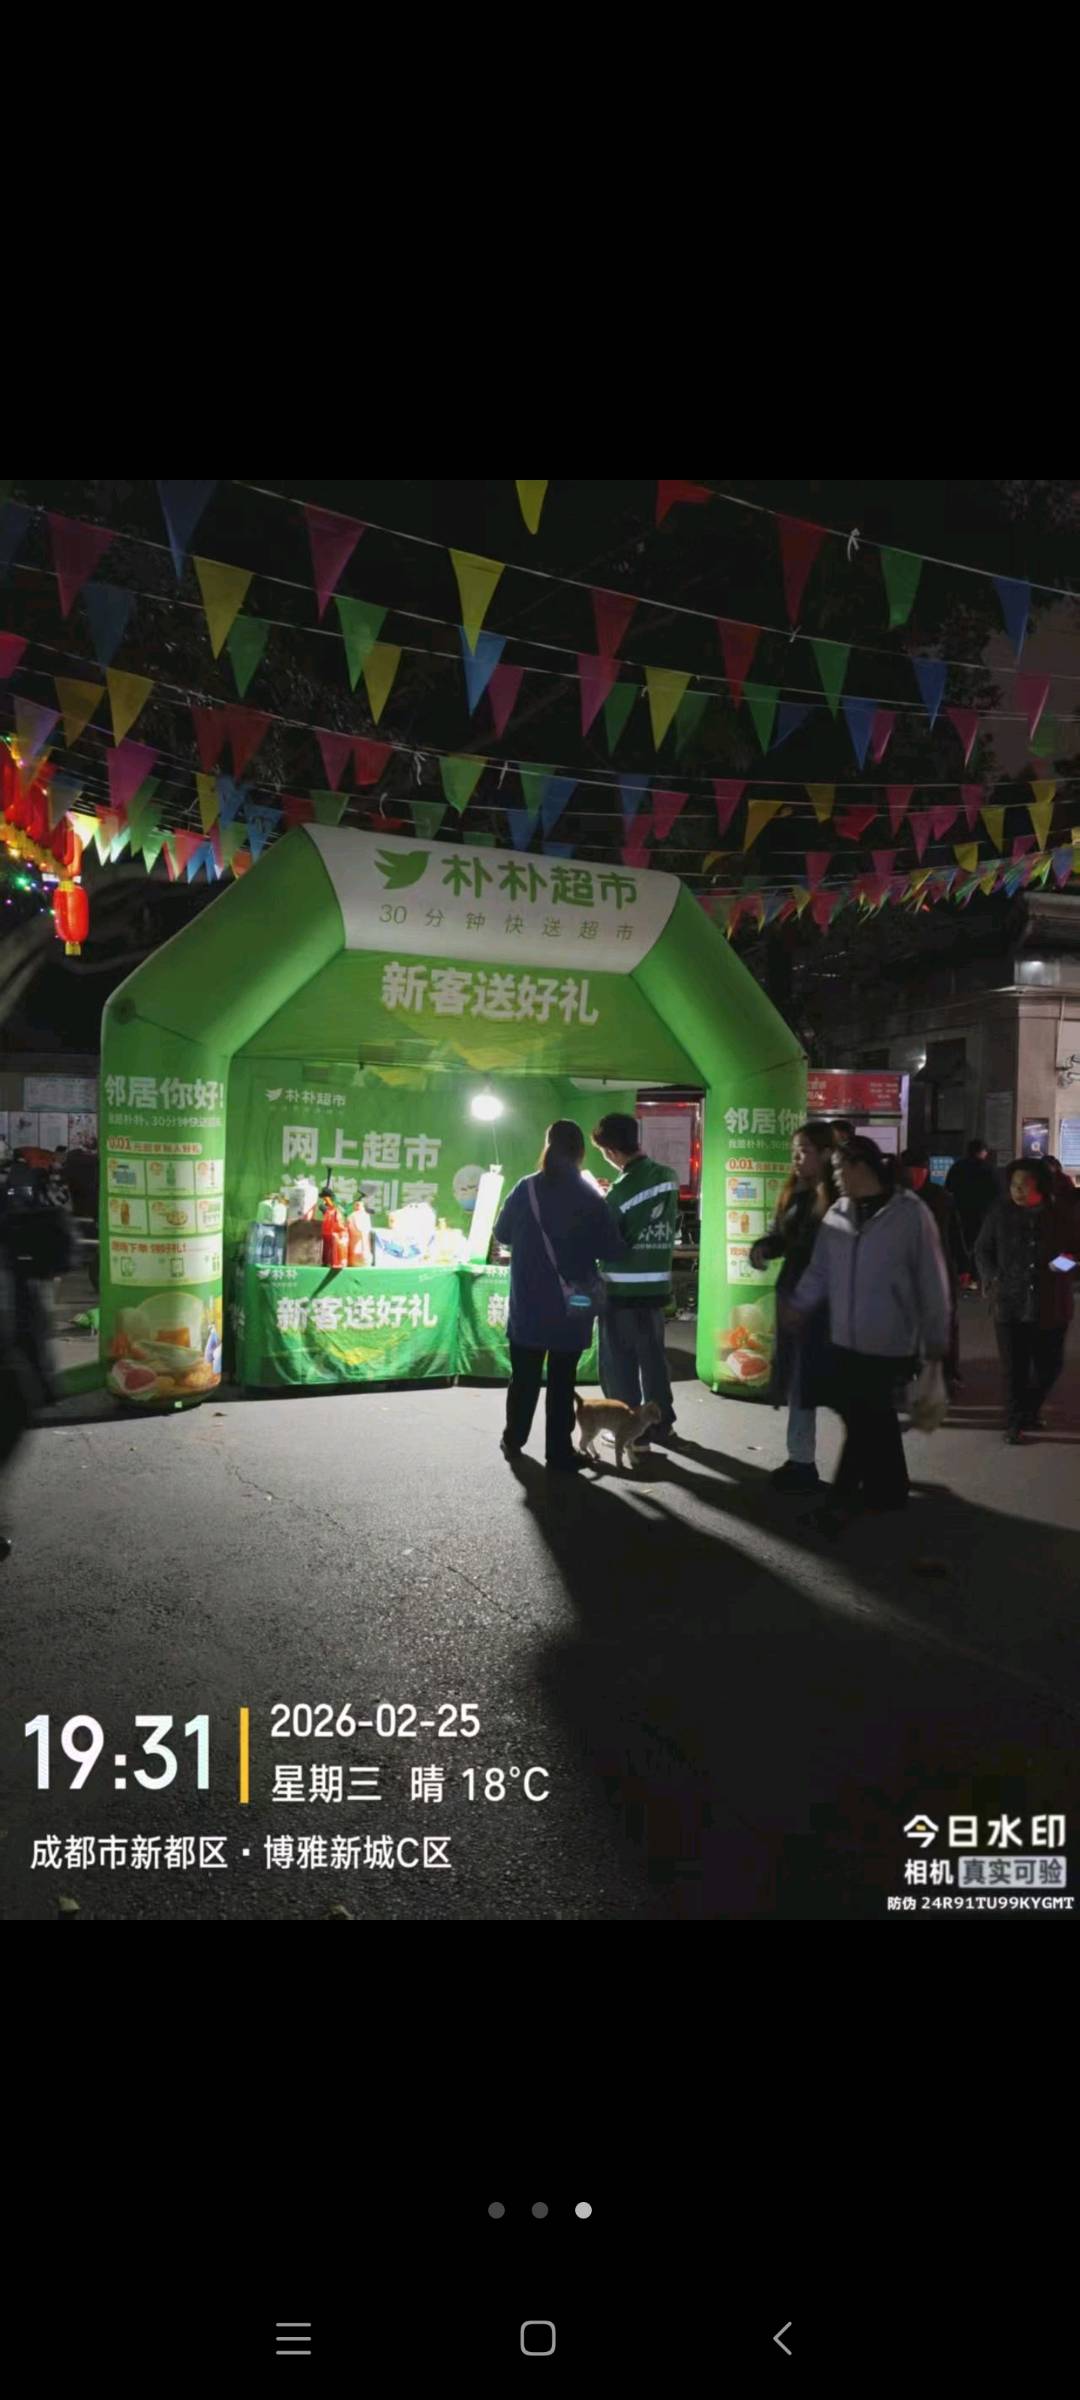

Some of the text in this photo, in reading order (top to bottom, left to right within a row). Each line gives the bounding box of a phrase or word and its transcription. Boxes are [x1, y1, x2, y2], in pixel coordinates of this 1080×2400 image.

[440, 854, 639, 911] 朴朴超市
[379, 904, 634, 941] 30分钟快送超市
[381, 961, 600, 1026] 新客送好礼
[285, 1089, 346, 1106] 朴朴超市
[282, 1125, 442, 1170] 网上超市
[276, 1293, 438, 1331] 新客送好礼
